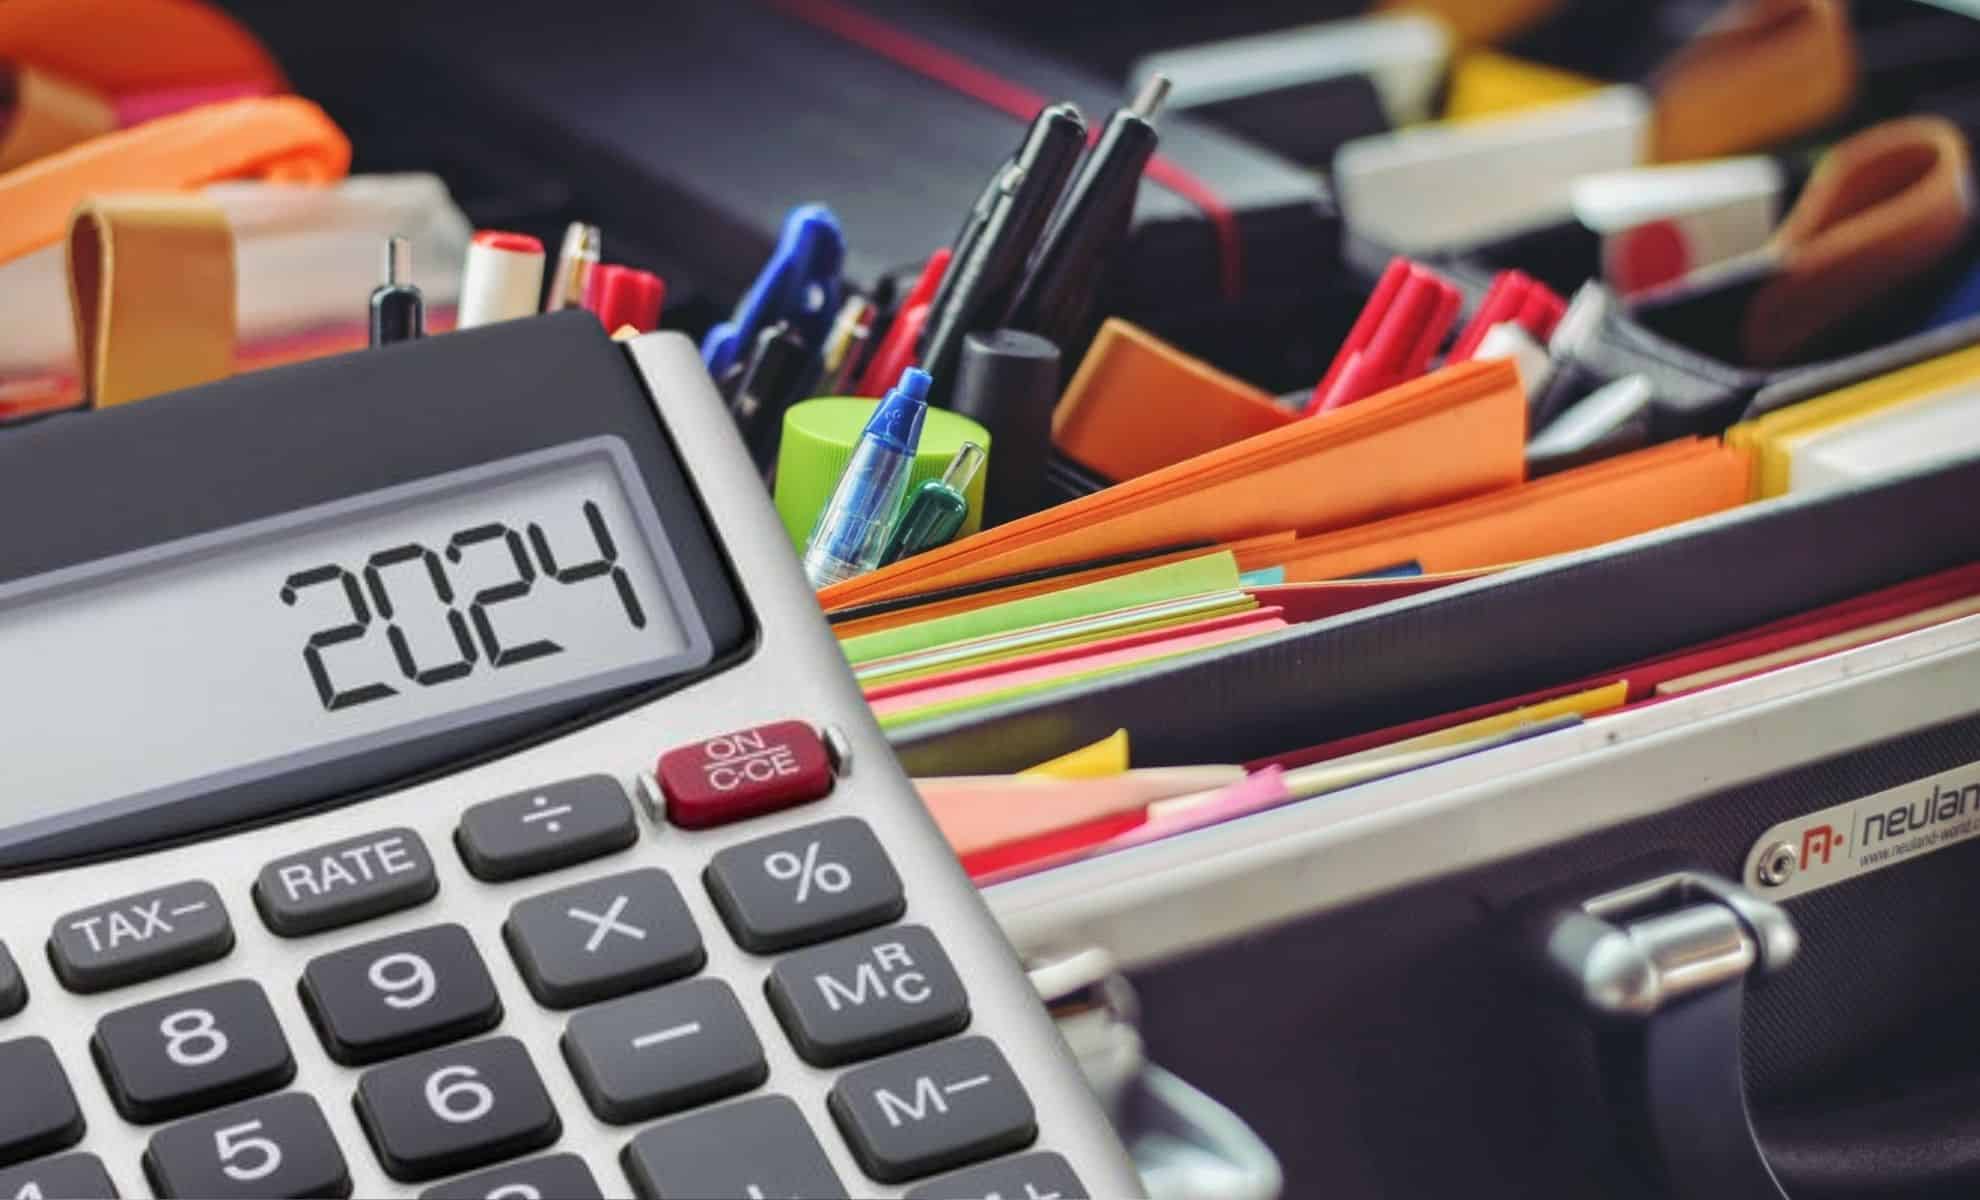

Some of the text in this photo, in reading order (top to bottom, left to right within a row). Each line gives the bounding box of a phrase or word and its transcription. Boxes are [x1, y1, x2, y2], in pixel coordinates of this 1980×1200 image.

[280, 500, 647, 711] 2024
[704, 728, 766, 760] ON
[278, 838, 416, 901] RATE
[764, 842, 851, 903] %
[368, 953, 437, 1008] 9
[160, 1009, 229, 1066] 8
[425, 1065, 494, 1123] 6
[213, 1120, 282, 1180] 5
